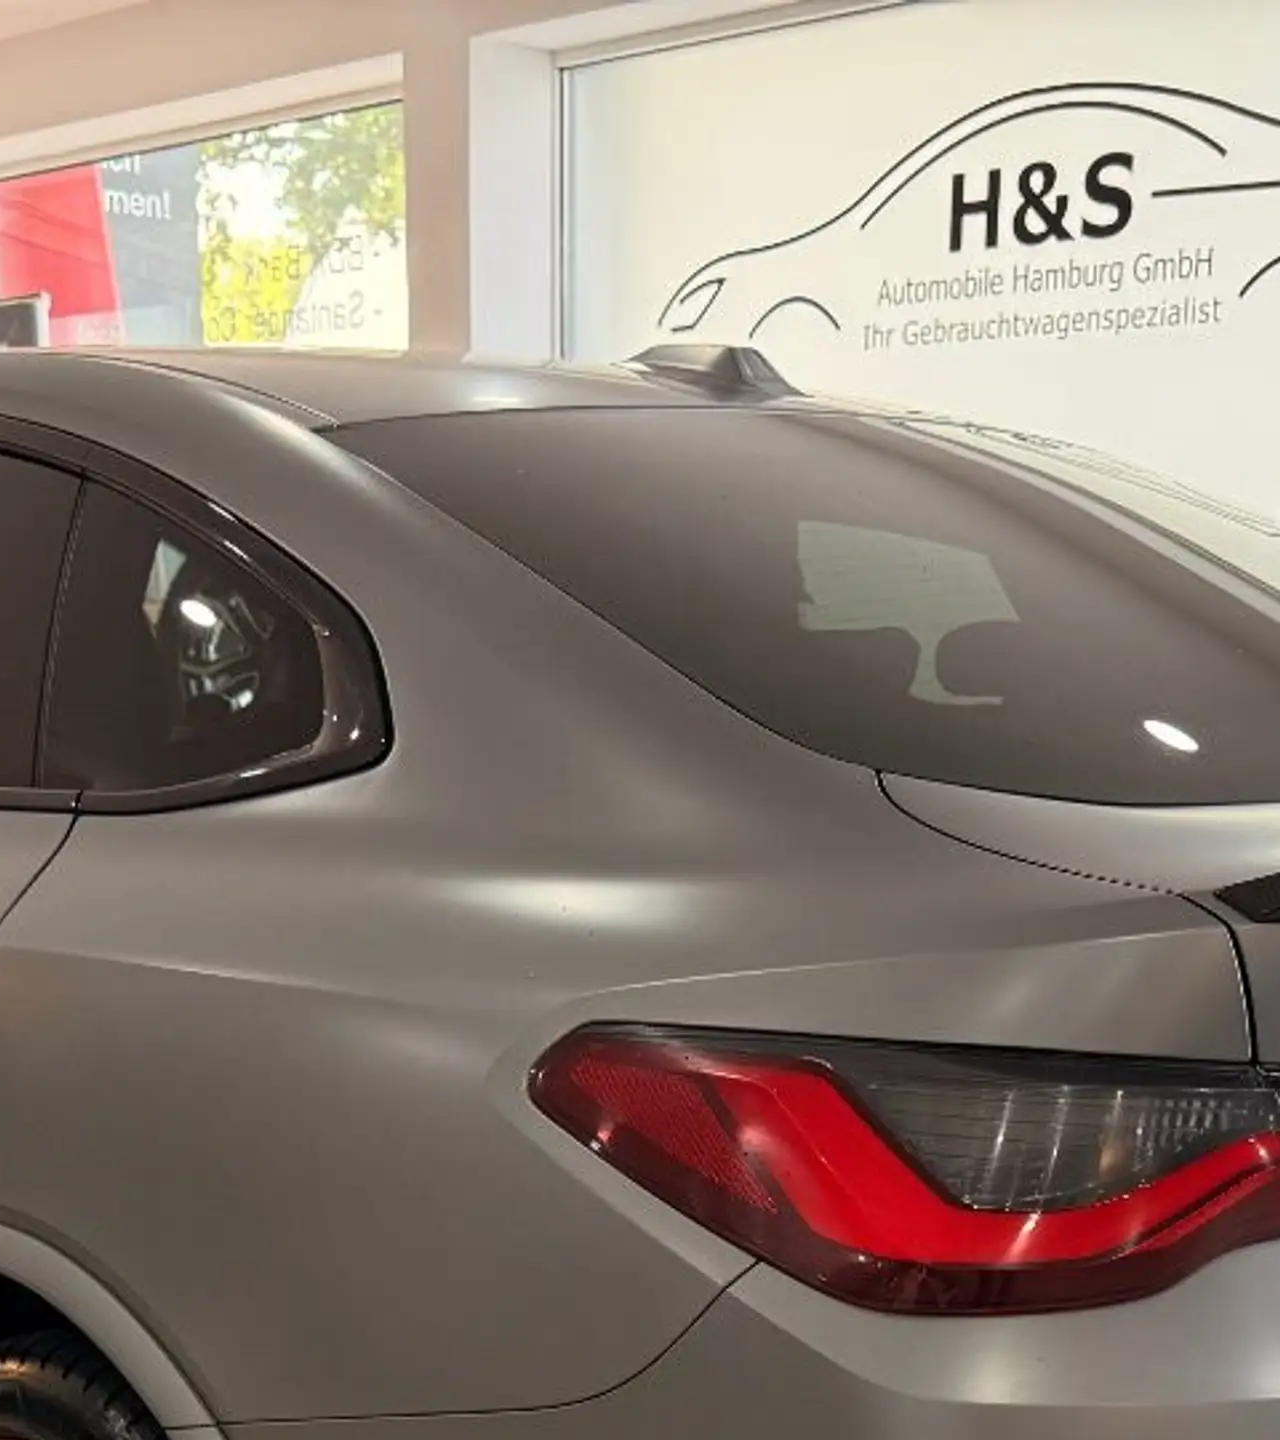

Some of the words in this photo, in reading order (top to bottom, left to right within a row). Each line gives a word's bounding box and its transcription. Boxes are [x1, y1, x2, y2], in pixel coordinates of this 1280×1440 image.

[949, 151, 1136, 254] H&S
[877, 266, 1005, 308] Automobile
[1012, 258, 1125, 294] Hamburg
[1132, 247, 1216, 285] GmbH
[862, 322, 897, 351] Ihr
[901, 296, 1224, 347] Gebrauchtwagenspezialist
